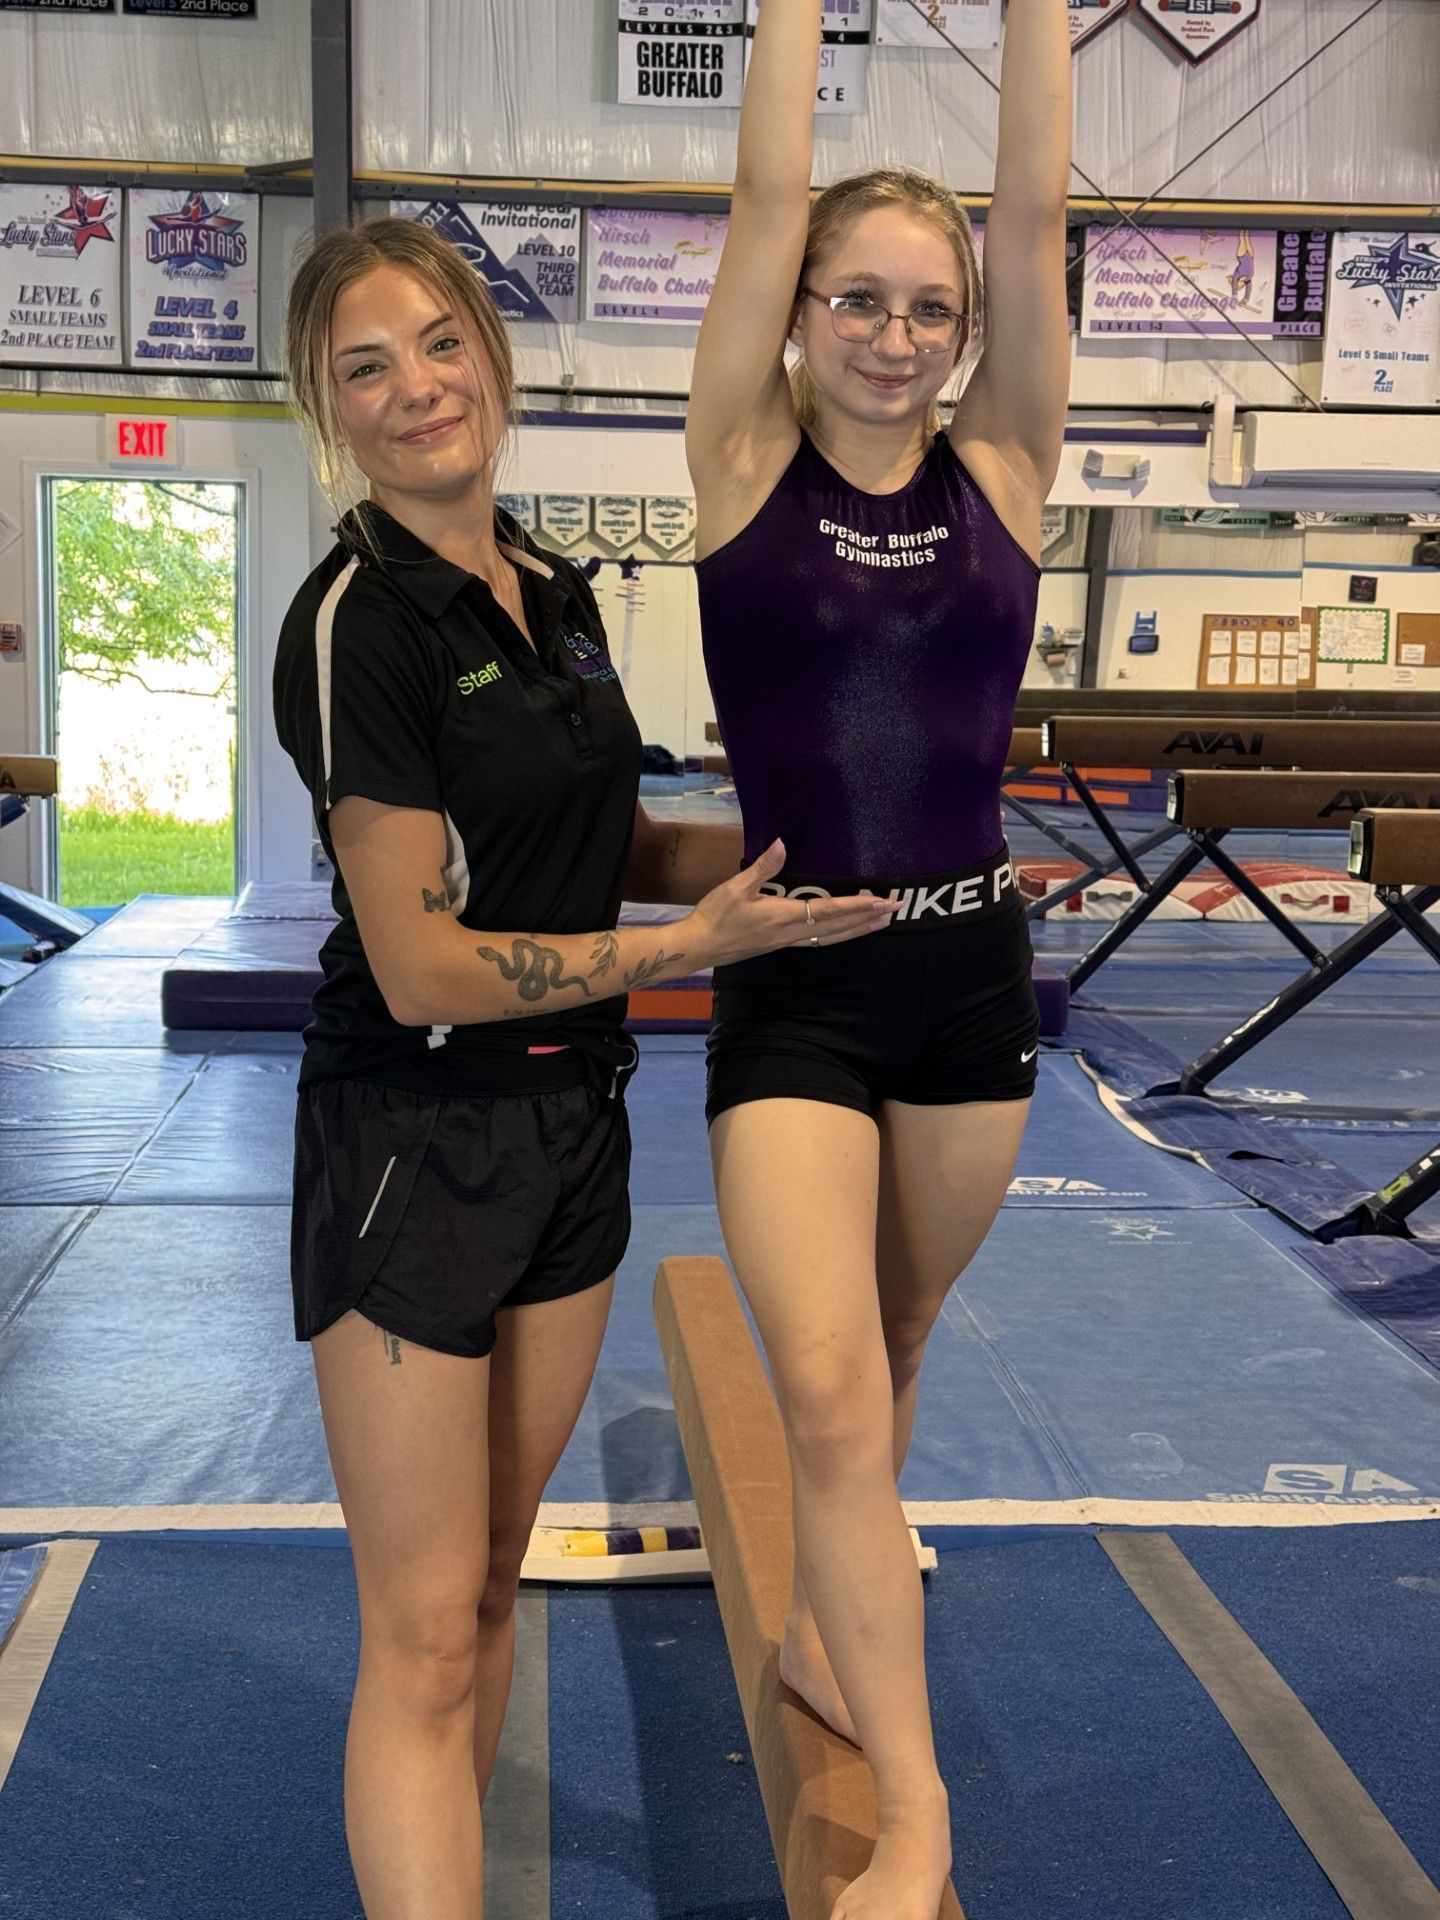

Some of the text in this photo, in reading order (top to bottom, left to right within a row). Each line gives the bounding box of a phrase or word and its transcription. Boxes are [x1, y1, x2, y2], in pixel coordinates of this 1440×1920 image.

[210, 0, 249, 12] Place
[625, 22, 733, 35] LEVELS 2&3
[636, 41, 723, 70] GREATER
[638, 71, 722, 98] BUFFALO
[481, 211, 577, 229] Invitational
[0, 221, 76, 250] Lucky Stars
[598, 227, 650, 245] Hirsch
[147, 228, 246, 265] LUCKY STARS
[517, 243, 575, 257] LEVEL 10
[537, 261, 575, 273] THIRD
[598, 250, 677, 270] Memorial
[536, 273, 575, 285] PLACE
[1095, 269, 1173, 287] Memorial
[1336, 262, 1391, 283] Lucky
[538, 284, 575, 296] TEAM
[597, 273, 658, 293] Buffalo
[1385, 282, 1437, 290] INVITATIONAL
[18, 285, 102, 307] LEVEL 6
[1094, 291, 1238, 312] Buffalo Challenge
[155, 296, 239, 320] LEVEL 4
[602, 305, 659, 316] LEVEL 4
[8, 310, 107, 329] SMALL TEAMS
[1097, 322, 1142, 332] LEVEL
[1280, 323, 1316, 333] PLACE
[0, 329, 116, 349] 2nd PLACE TEAM
[148, 321, 246, 341] SMALL TEAMS
[135, 340, 165, 359] 2nd
[214, 346, 254, 363] TEAM
[1338, 349, 1430, 362] Level 5 Small Teams
[1373, 385, 1393, 394] PLACE
[119, 421, 167, 457] EXIT
[819, 518, 949, 550] Greater Buffalo
[835, 541, 936, 568] Gymnastics
[457, 661, 503, 695] Staff
